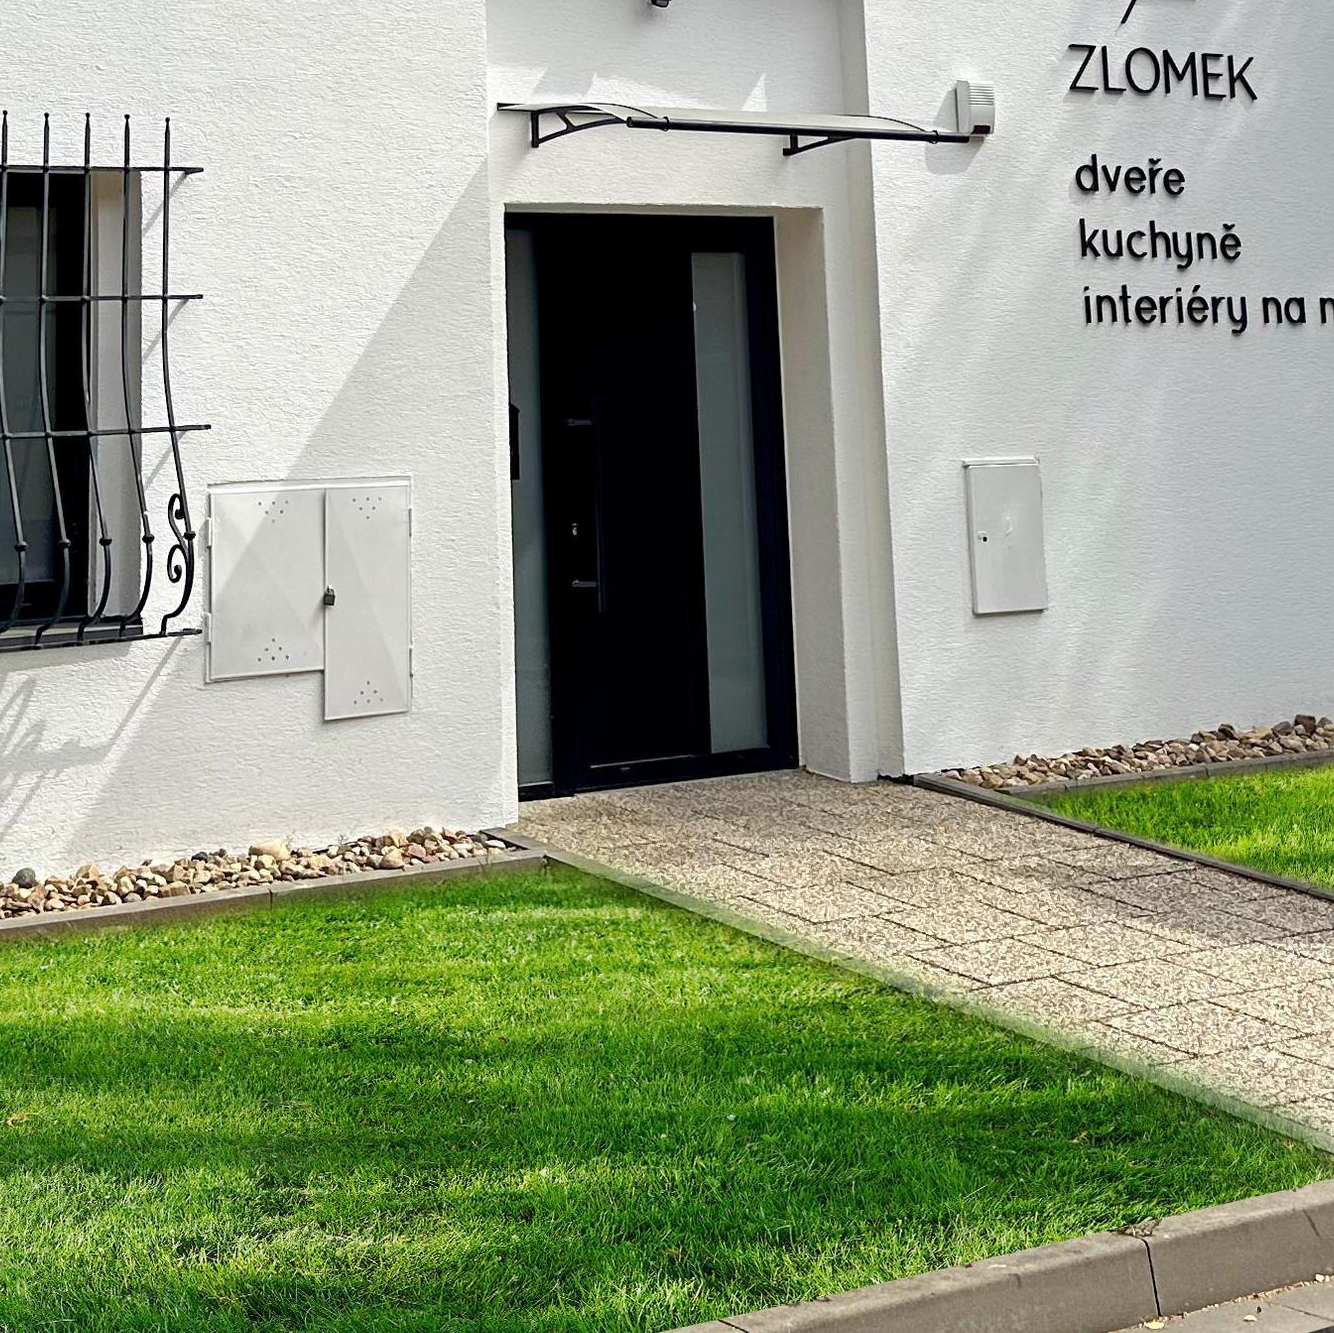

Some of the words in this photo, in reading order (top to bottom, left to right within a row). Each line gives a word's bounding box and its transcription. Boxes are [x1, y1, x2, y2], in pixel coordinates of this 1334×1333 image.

[1068, 43, 1258, 101] ZLOMEK
[1075, 154, 1186, 197] dveře
[1079, 218, 1242, 269] kuchyně
[1083, 284, 1248, 335] interiéry
[1262, 295, 1307, 325] na
